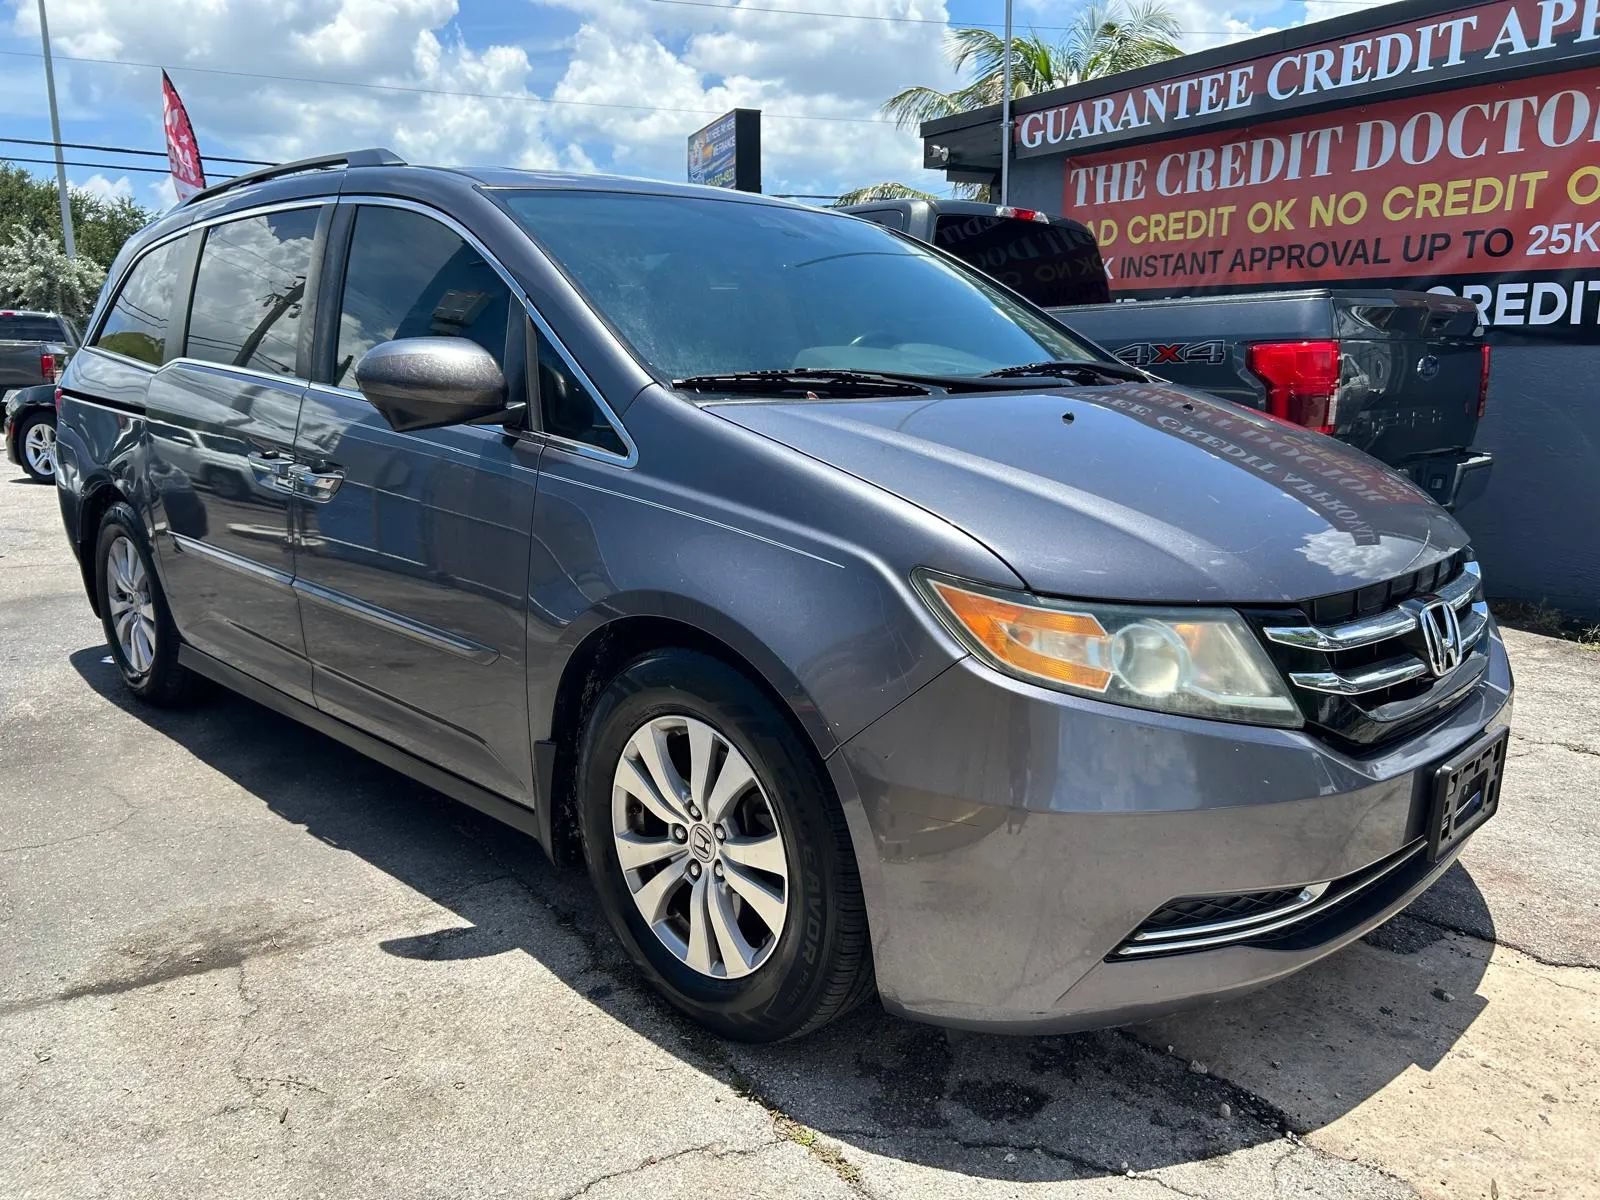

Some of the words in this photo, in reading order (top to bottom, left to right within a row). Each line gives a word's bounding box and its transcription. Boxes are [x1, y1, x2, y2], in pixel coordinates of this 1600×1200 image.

[1020, 66, 1254, 149] GUARANTEE
[1266, 15, 1478, 101] CREDIT
[1070, 158, 1148, 208] THE
[1156, 126, 1344, 197] CREDIT
[1127, 205, 1236, 245] CREDIT
[1247, 198, 1298, 234] OK
[1309, 191, 1368, 229] NO
[1382, 170, 1549, 222] CREDIT
[1120, 249, 1223, 279] INSTANT
[1228, 237, 1391, 274] APPROVAL
[1403, 233, 1451, 262] UP
[1462, 227, 1514, 259] TO
[1526, 222, 1600, 257] 25K
